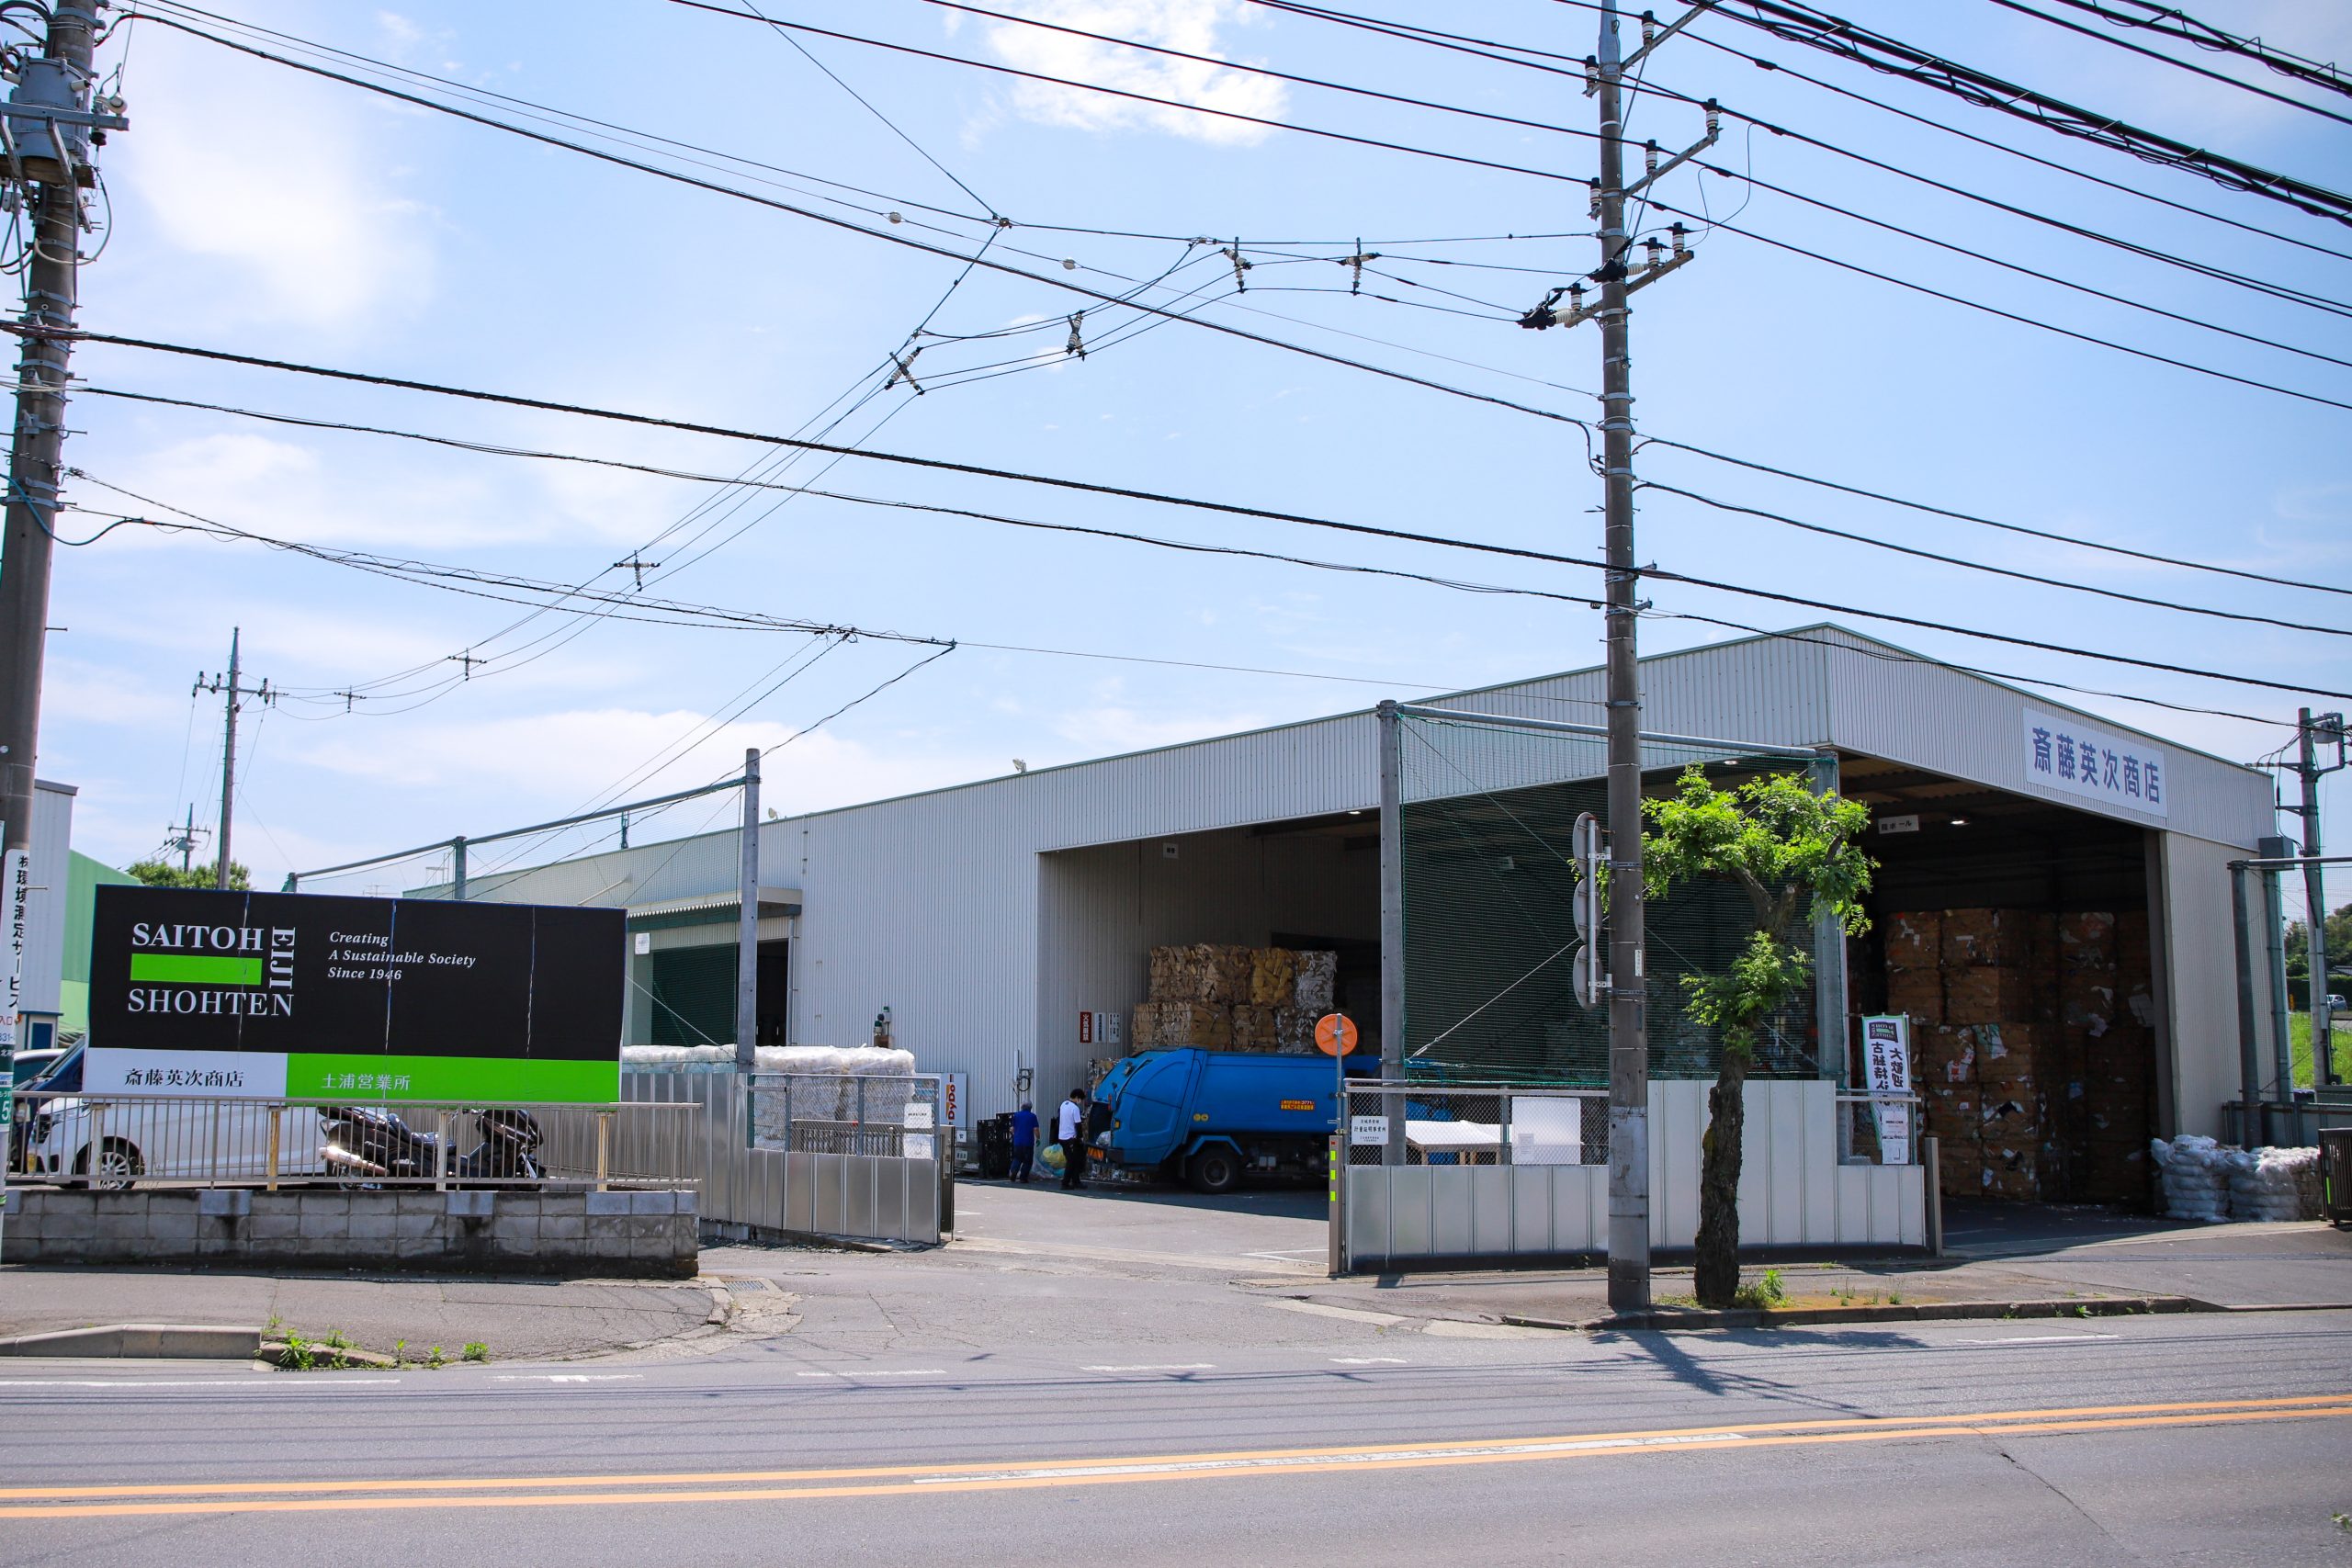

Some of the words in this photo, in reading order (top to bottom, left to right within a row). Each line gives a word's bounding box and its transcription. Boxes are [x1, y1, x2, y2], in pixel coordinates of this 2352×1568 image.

[2032, 727, 2160, 804] 斎藤英次商店
[131, 922, 265, 951] SAITOH
[329, 931, 389, 947] Creating
[269, 926, 296, 989] EIJI
[328, 950, 339, 961] A
[343, 950, 424, 963] Sustainable
[428, 953, 476, 968] Society
[327, 966, 365, 979] Since
[369, 968, 402, 980] 1946
[128, 988, 294, 1017] SHOHTEN
[124, 1068, 244, 1088] 斎藤英次商店
[321, 1073, 411, 1091] 土浦営業所
[947, 1085, 957, 1120] DyDo
